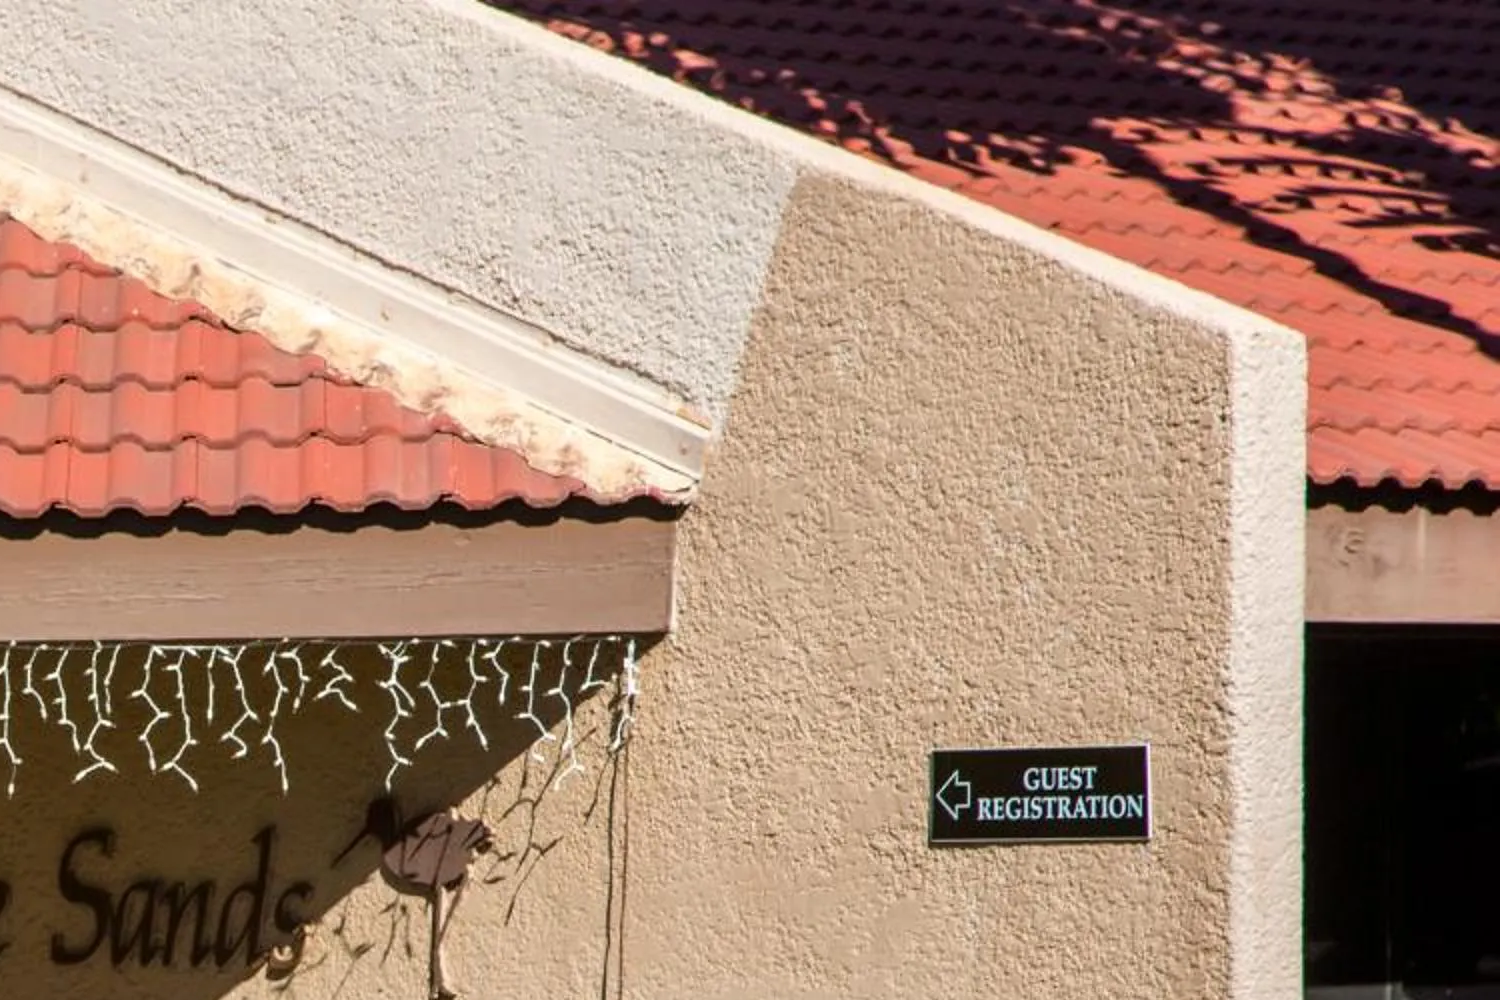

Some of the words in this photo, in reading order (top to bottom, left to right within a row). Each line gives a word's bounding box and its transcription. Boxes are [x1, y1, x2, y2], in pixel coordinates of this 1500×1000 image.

[1023, 765, 1097, 791] GUEST
[976, 794, 1145, 821] REGISTRATION
[50, 823, 316, 979] Sands
